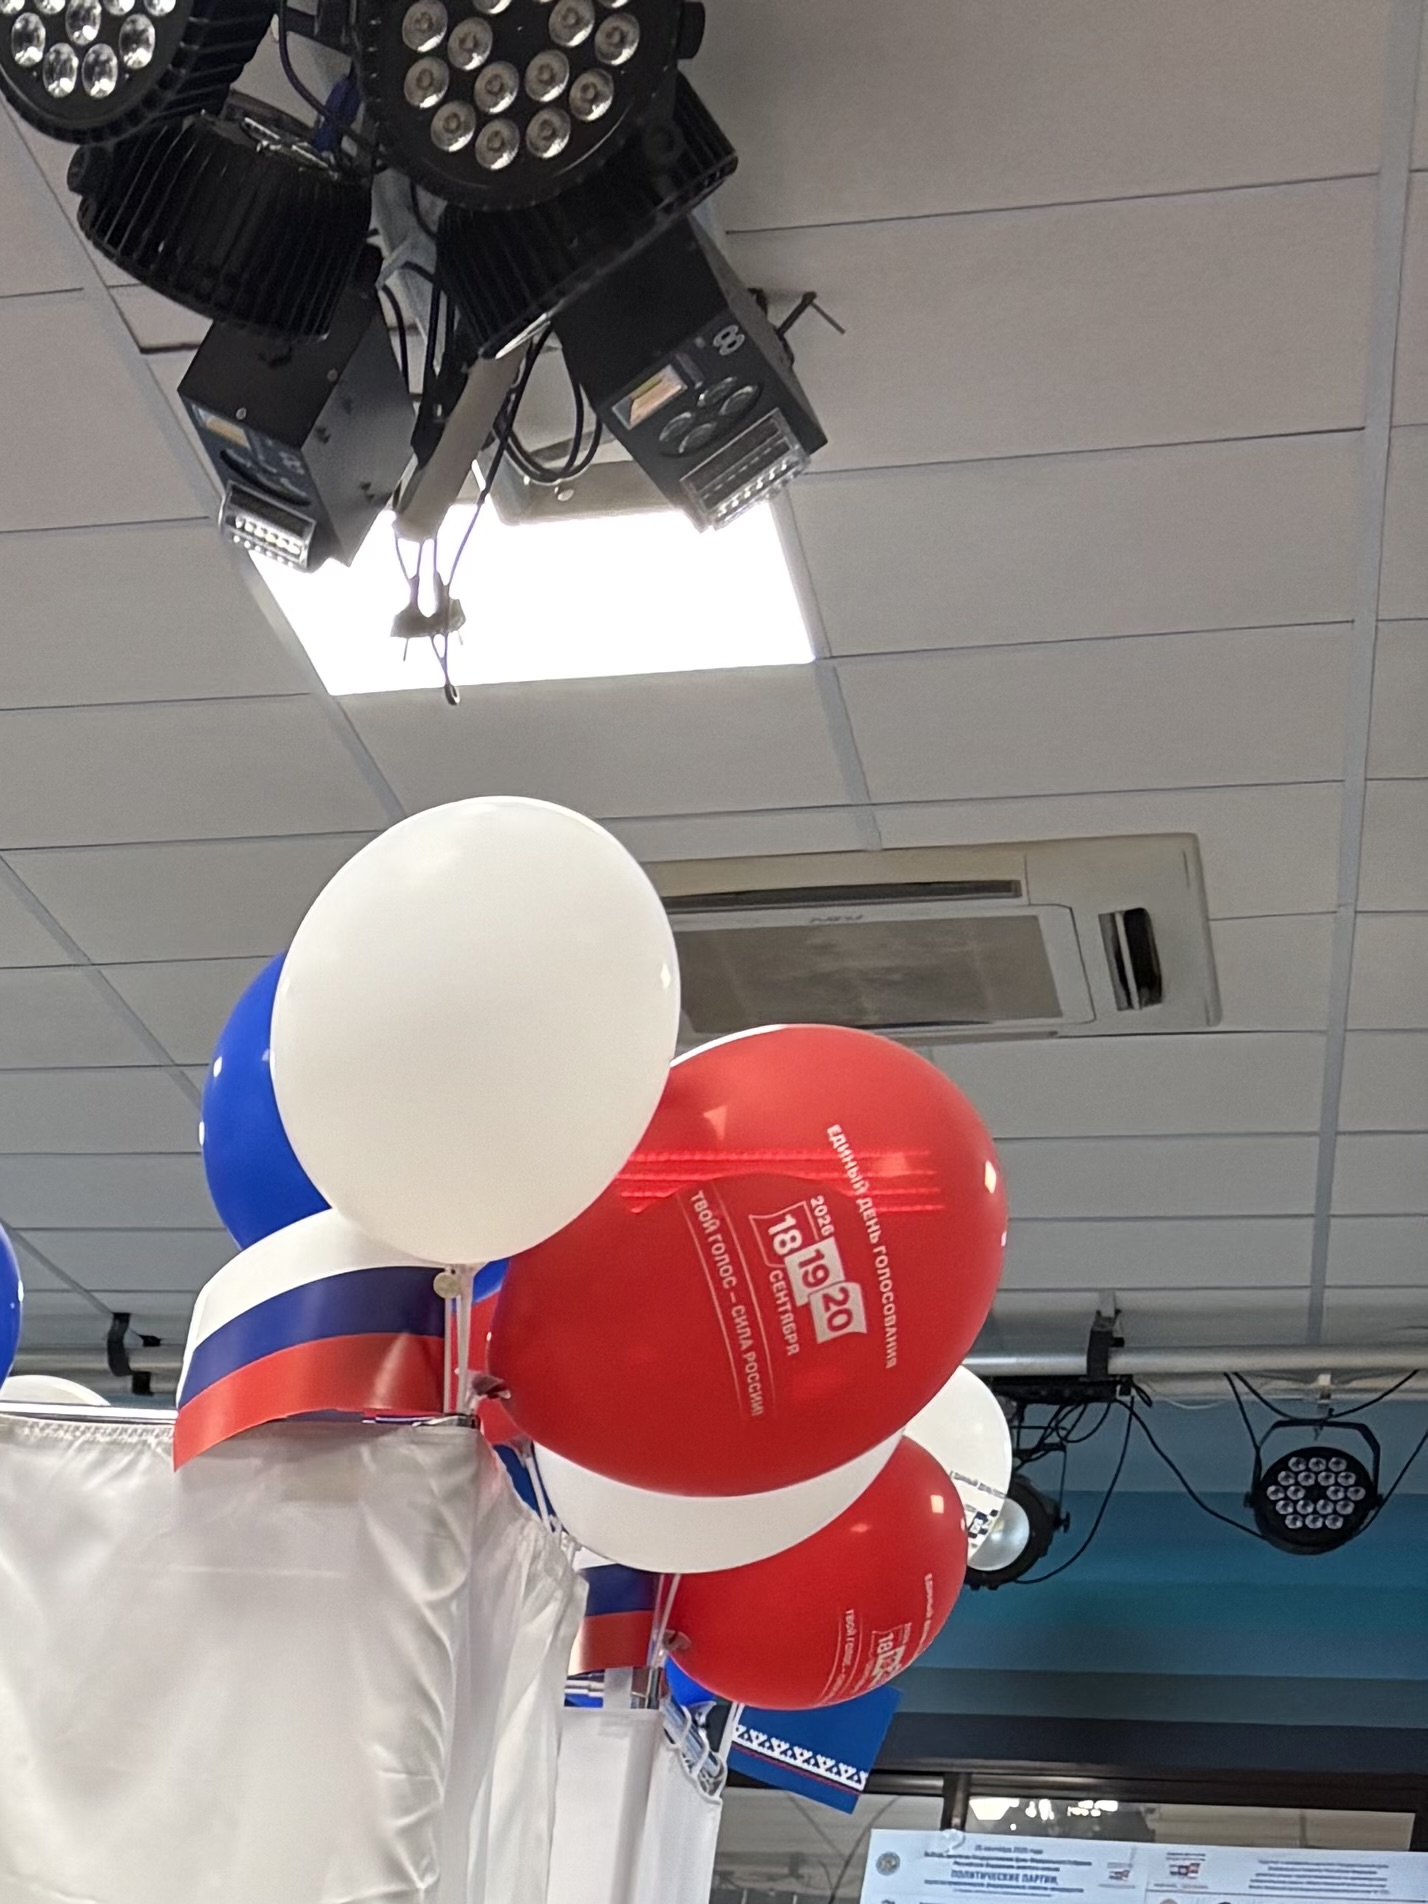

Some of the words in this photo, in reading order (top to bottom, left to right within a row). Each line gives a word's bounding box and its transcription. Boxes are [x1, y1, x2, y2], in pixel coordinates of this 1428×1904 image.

[691, 1190, 719, 1234] ТВОЙ
[767, 1213, 803, 1257] 18
[810, 1195, 835, 1237] 2026
[707, 1232, 738, 1289] ГОЛОС
[797, 1248, 831, 1289] 19
[827, 1124, 871, 1197] ЕДИНЫЙ
[855, 1197, 882, 1246] ДЕНЬ
[872, 1246, 897, 1369] ГОЛОСОВАНИЯ
[731, 1305, 754, 1352] СИЛА
[768, 1270, 800, 1357] СЕНТЯБРЯ
[821, 1286, 853, 1333] 20
[742, 1351, 764, 1417] РОССИИ!
